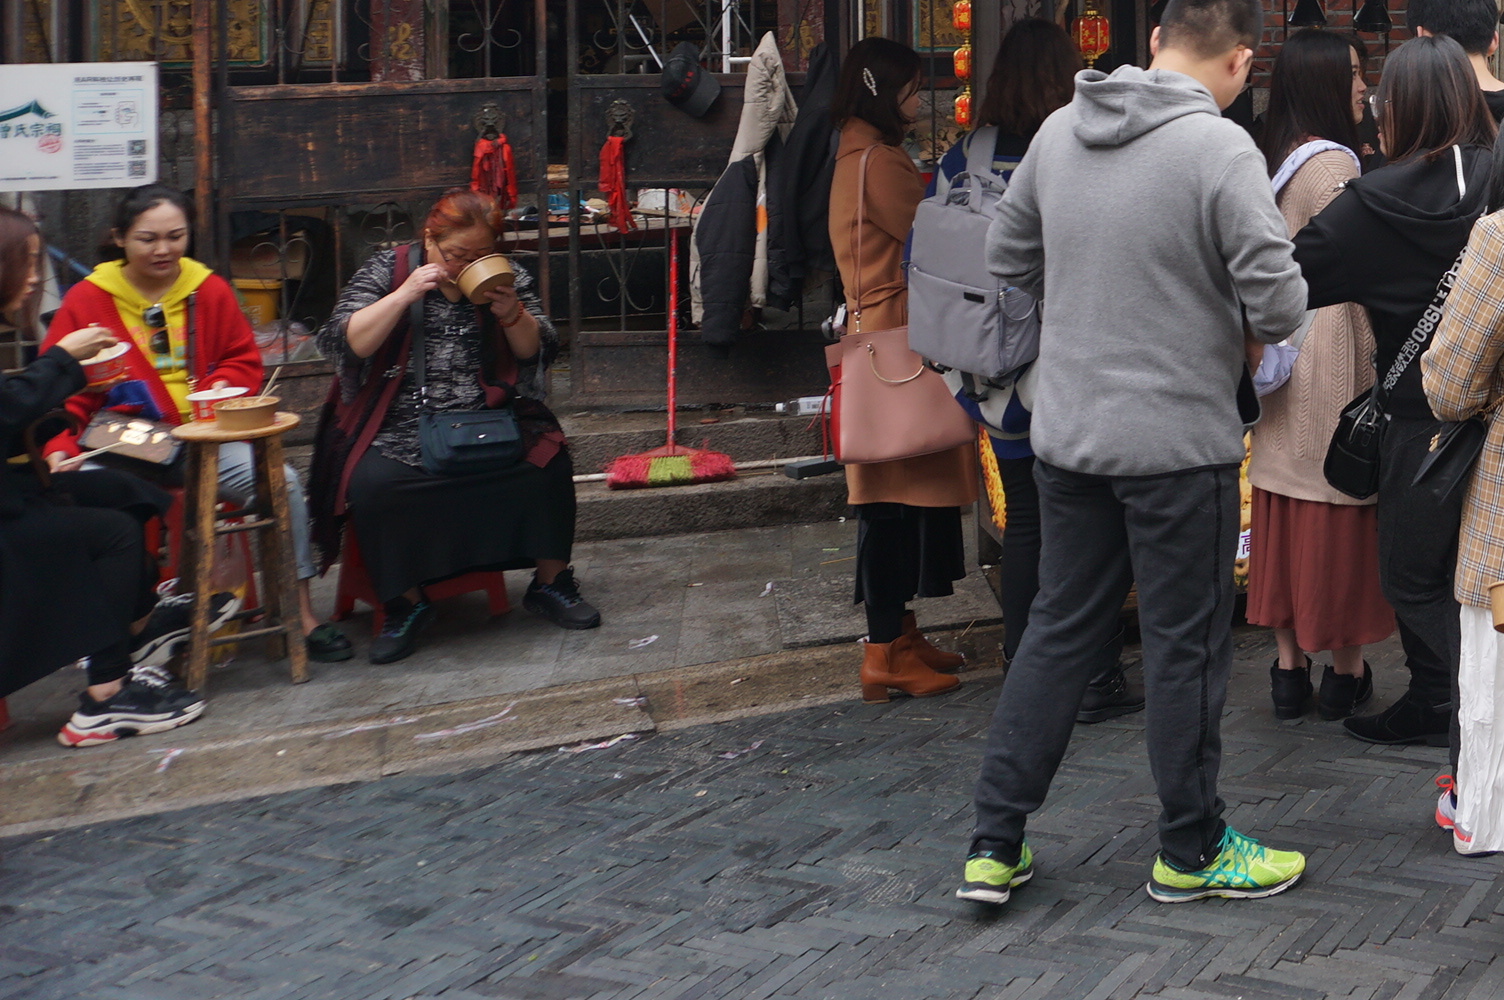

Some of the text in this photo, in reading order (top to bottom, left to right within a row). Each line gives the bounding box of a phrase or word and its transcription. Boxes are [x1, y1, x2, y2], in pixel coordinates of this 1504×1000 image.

[0, 123, 62, 139] 曾氏宗祠
[1411, 304, 1445, 343] 1980
